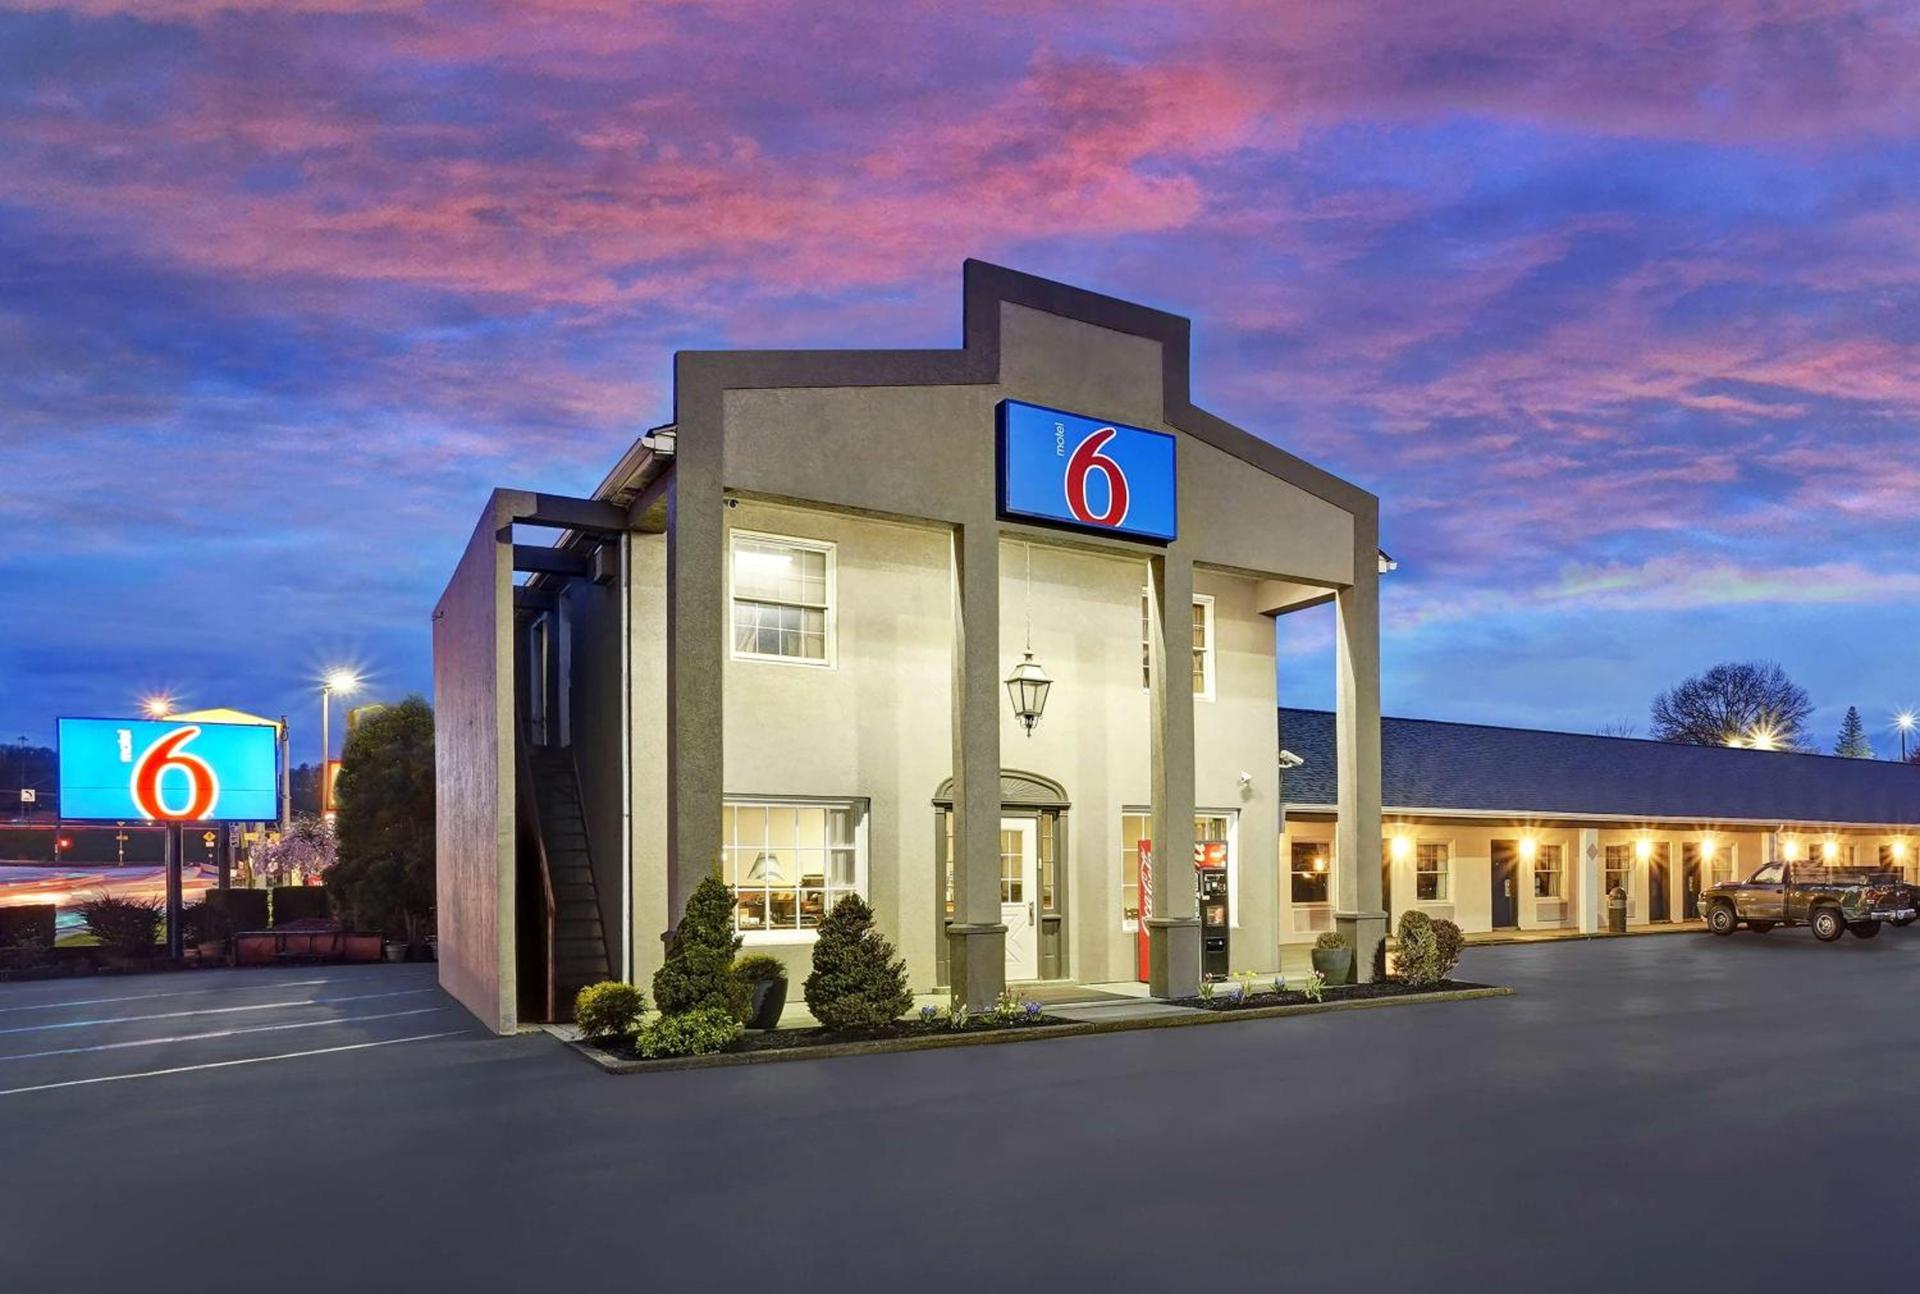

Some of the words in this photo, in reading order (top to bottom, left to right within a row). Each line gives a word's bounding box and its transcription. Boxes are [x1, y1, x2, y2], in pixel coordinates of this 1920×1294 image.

[1055, 422, 1065, 457] motel
[1064, 427, 1130, 527] 6
[130, 726, 219, 821] 6
